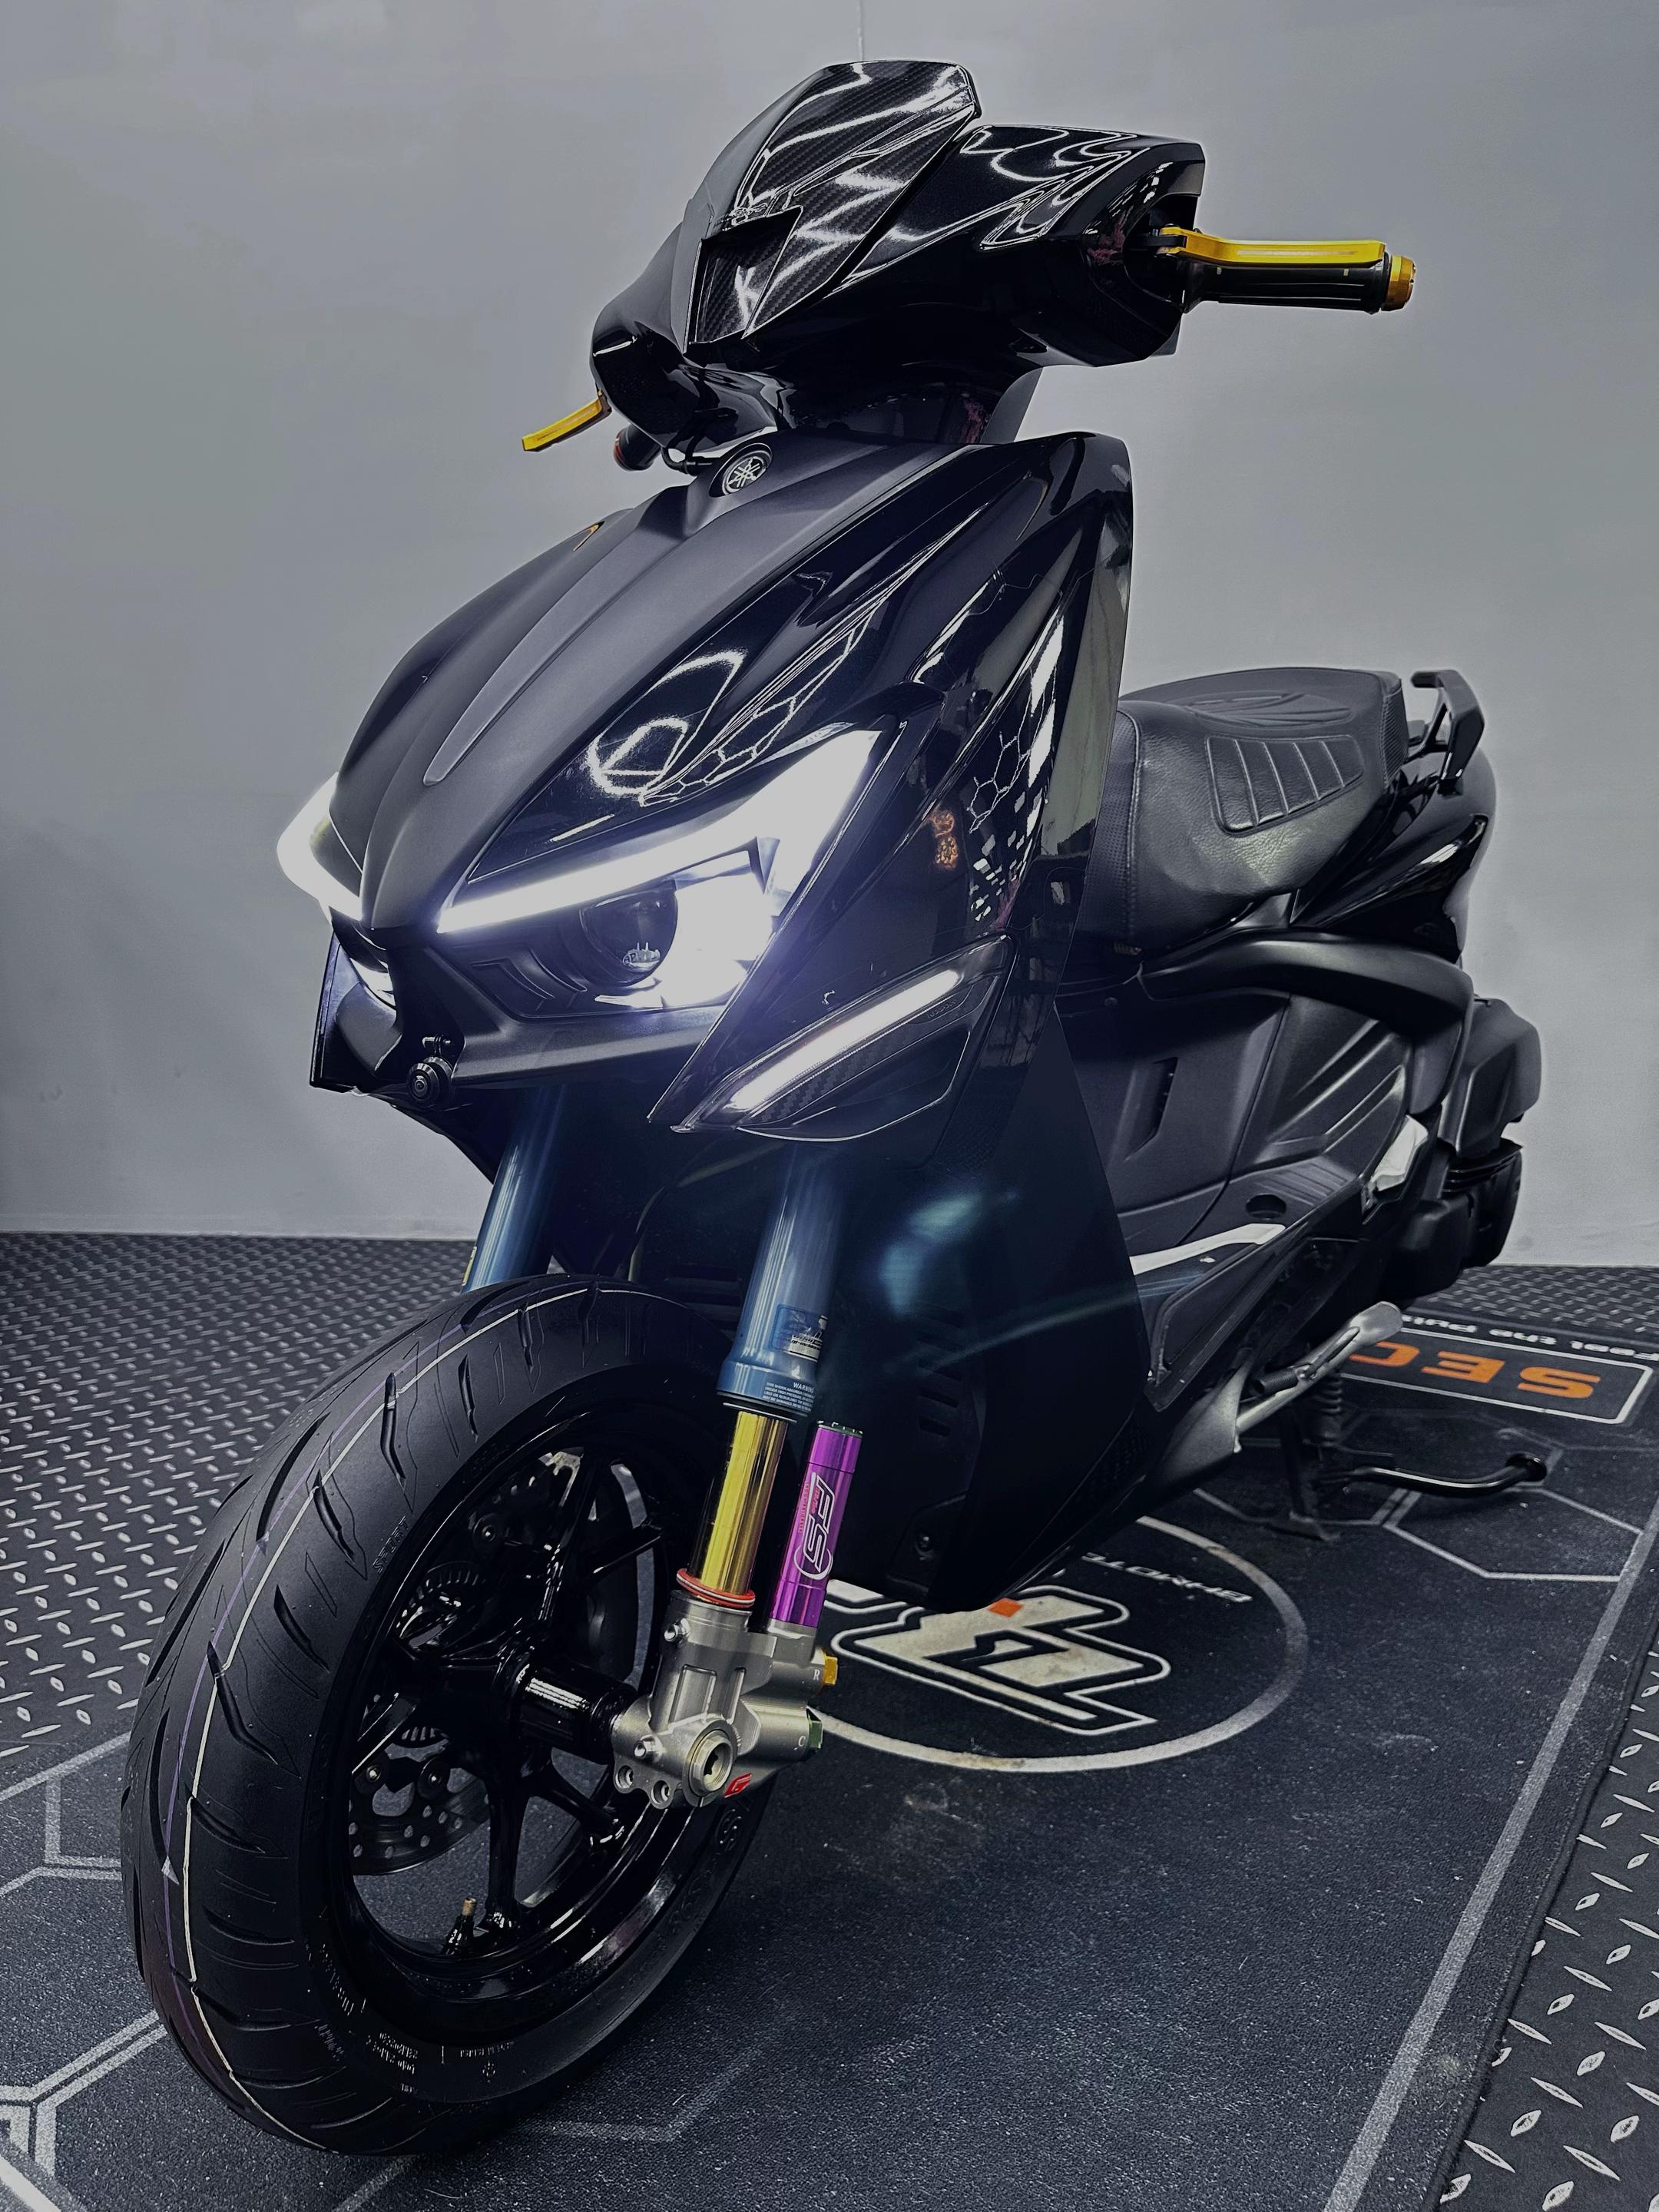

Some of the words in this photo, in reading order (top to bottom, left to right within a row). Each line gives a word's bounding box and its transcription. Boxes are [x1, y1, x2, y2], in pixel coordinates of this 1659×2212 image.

[372, 1515, 409, 1575] SPORT
[813, 1668, 821, 1681] R
[798, 1735, 806, 1747] C
